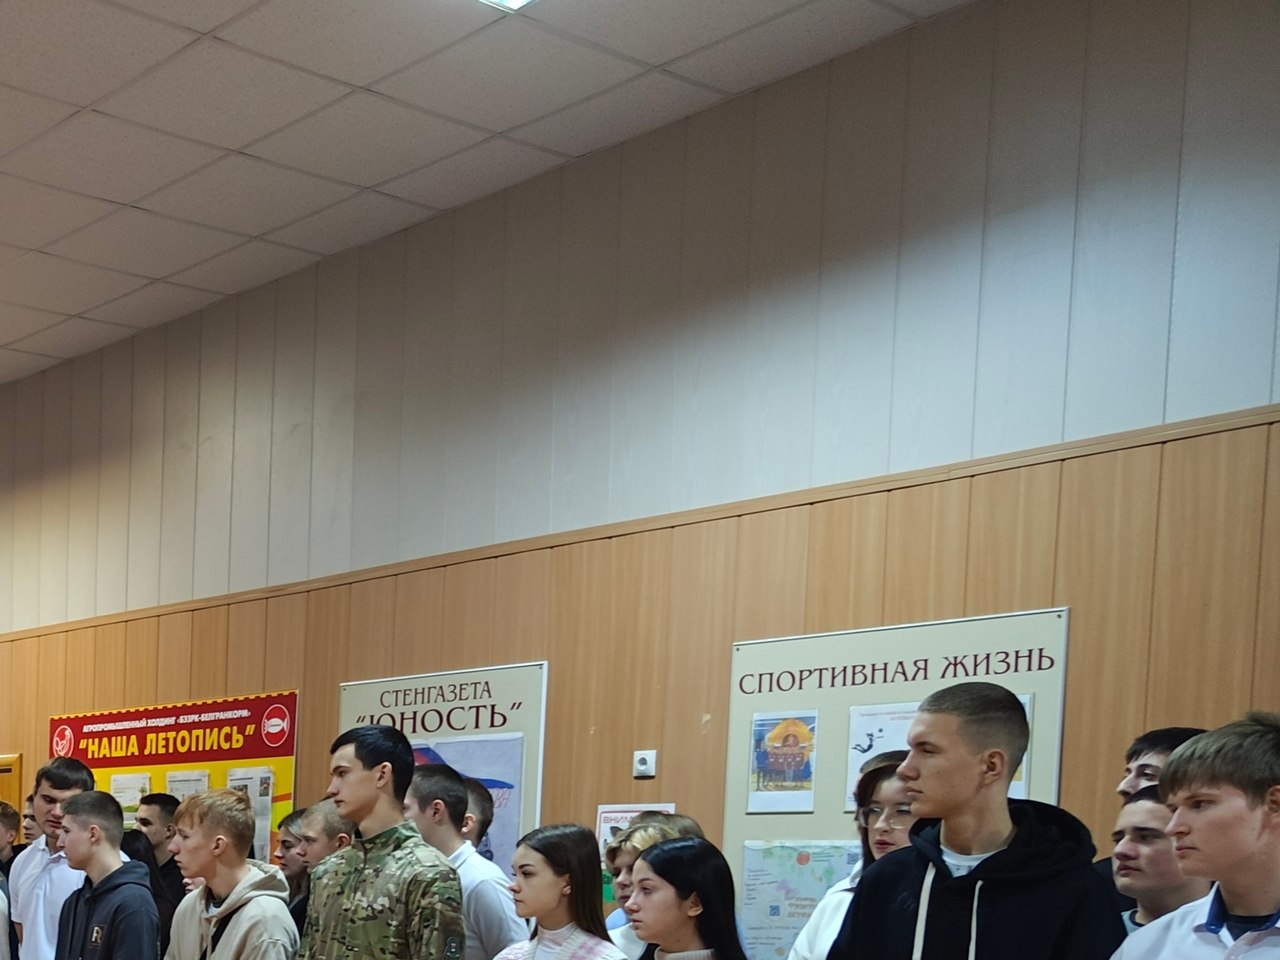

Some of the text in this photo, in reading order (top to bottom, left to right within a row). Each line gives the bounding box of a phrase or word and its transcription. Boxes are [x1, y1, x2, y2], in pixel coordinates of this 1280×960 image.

[738, 647, 1056, 695] СПОРТИВНАЯ ЖИЗНЬ
[379, 681, 492, 709] СТЕНГАЗЕТА
